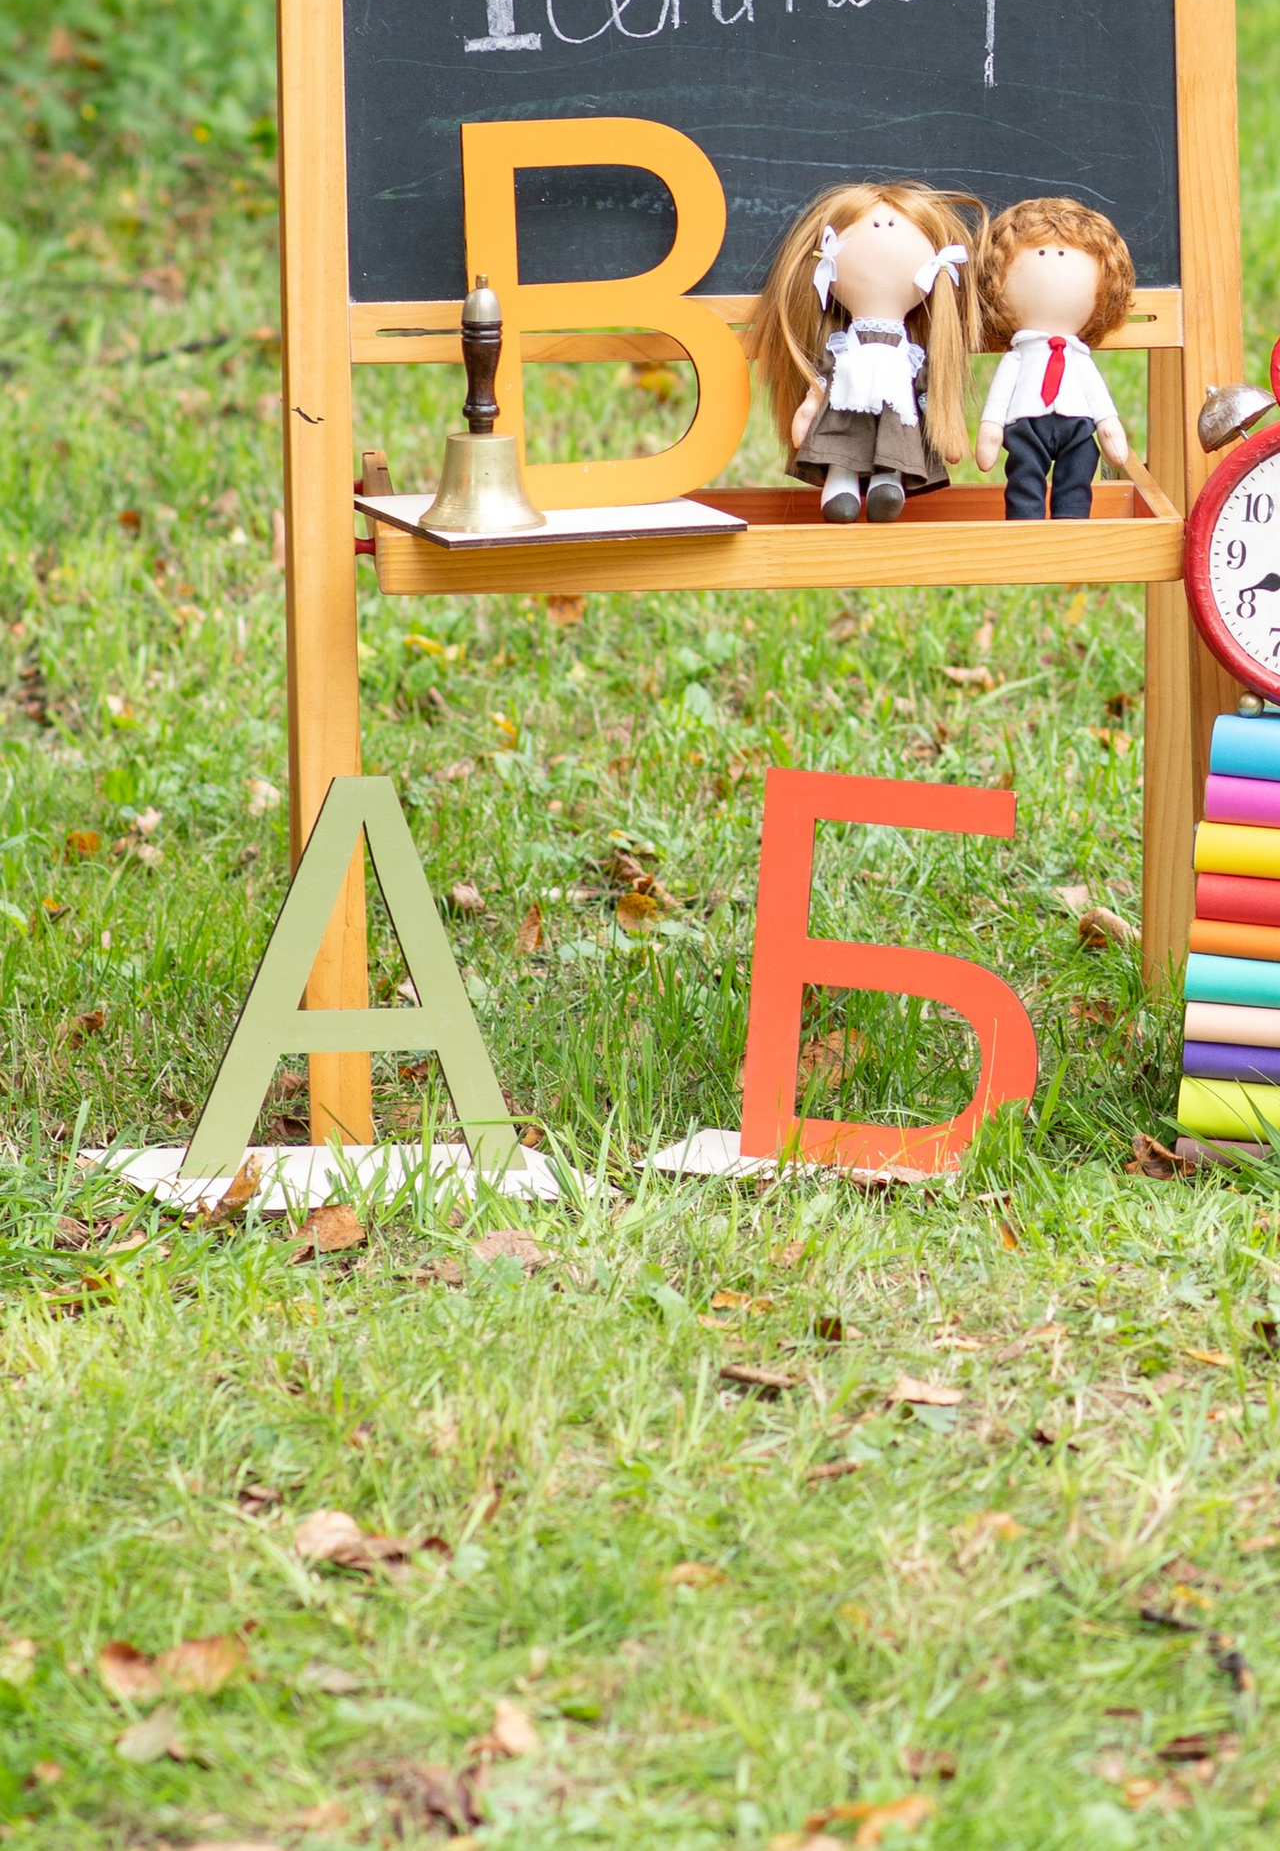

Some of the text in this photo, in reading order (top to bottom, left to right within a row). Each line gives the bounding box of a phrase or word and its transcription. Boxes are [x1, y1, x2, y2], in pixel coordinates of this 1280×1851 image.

[1241, 492, 1274, 523] 10
[1226, 539, 1246, 569] 9
[1235, 586, 1255, 618] 8
[740, 766, 1039, 1175] Б
